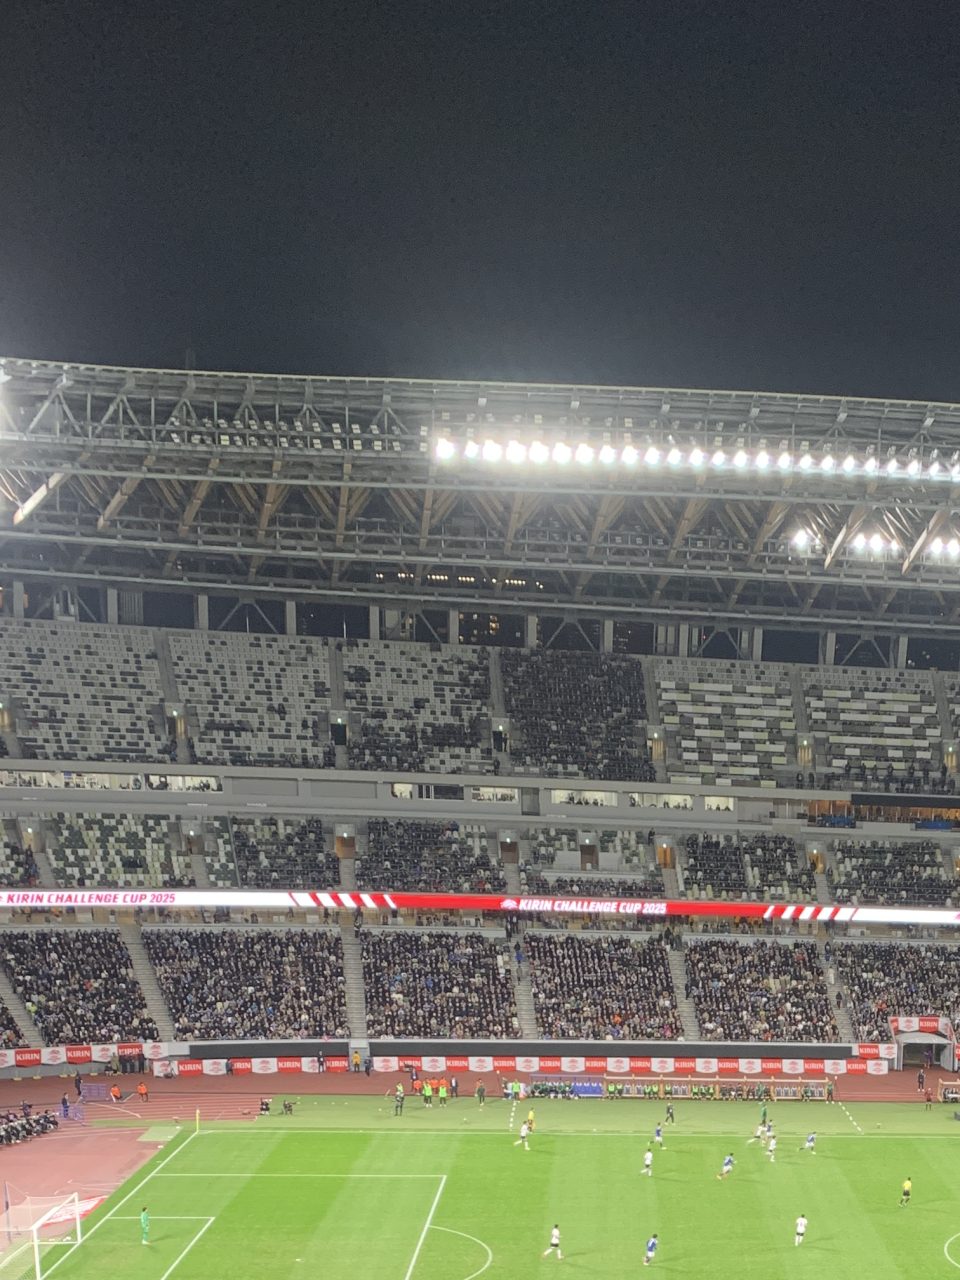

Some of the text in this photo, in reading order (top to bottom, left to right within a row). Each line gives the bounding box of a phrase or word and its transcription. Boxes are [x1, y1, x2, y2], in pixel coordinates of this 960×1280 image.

[6, 893, 176, 903] KIRIN CHALLENGE CUP 2025
[519, 899, 667, 914] KIRIN CHALLENGE CUP 2025
